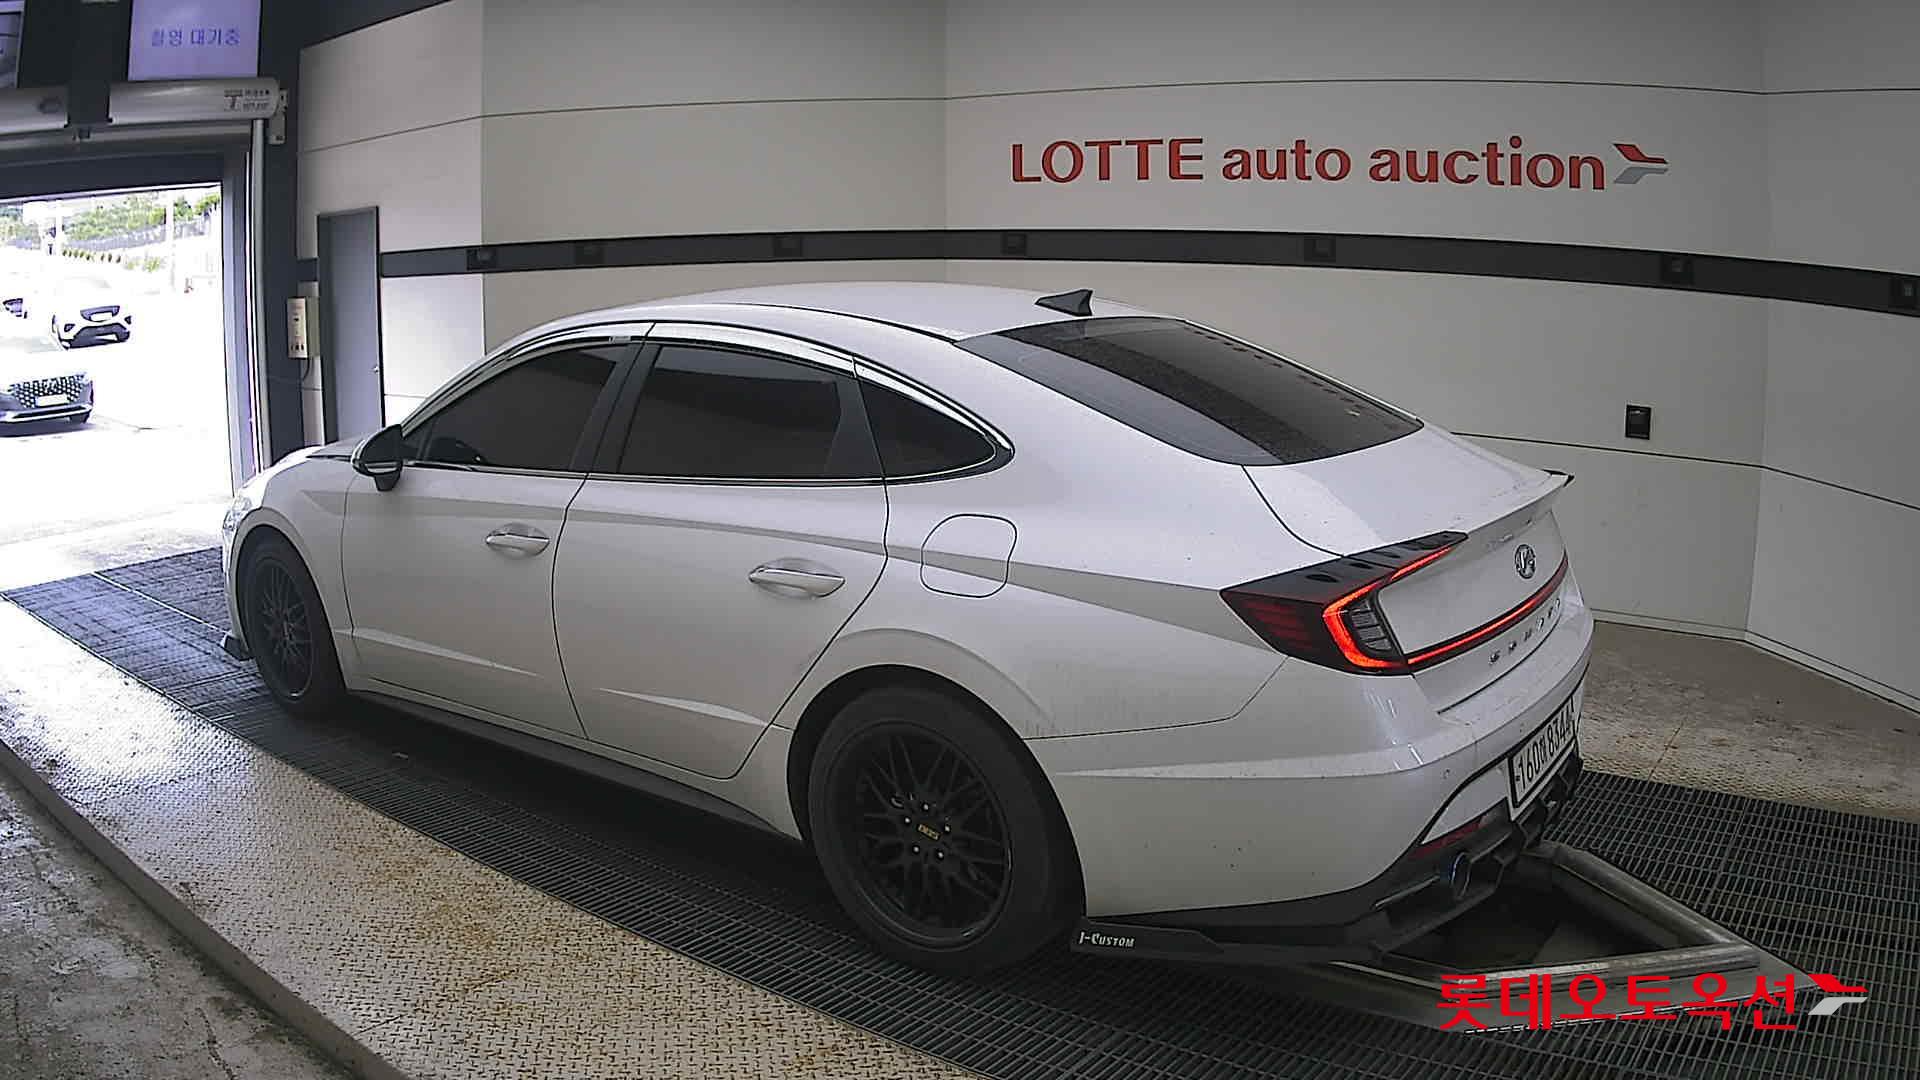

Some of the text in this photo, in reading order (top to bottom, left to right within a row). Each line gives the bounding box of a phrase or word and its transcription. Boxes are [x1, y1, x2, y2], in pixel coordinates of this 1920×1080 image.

[191, 28, 240, 46] 대기중
[1011, 136, 1605, 190] LOTTE auto auction
